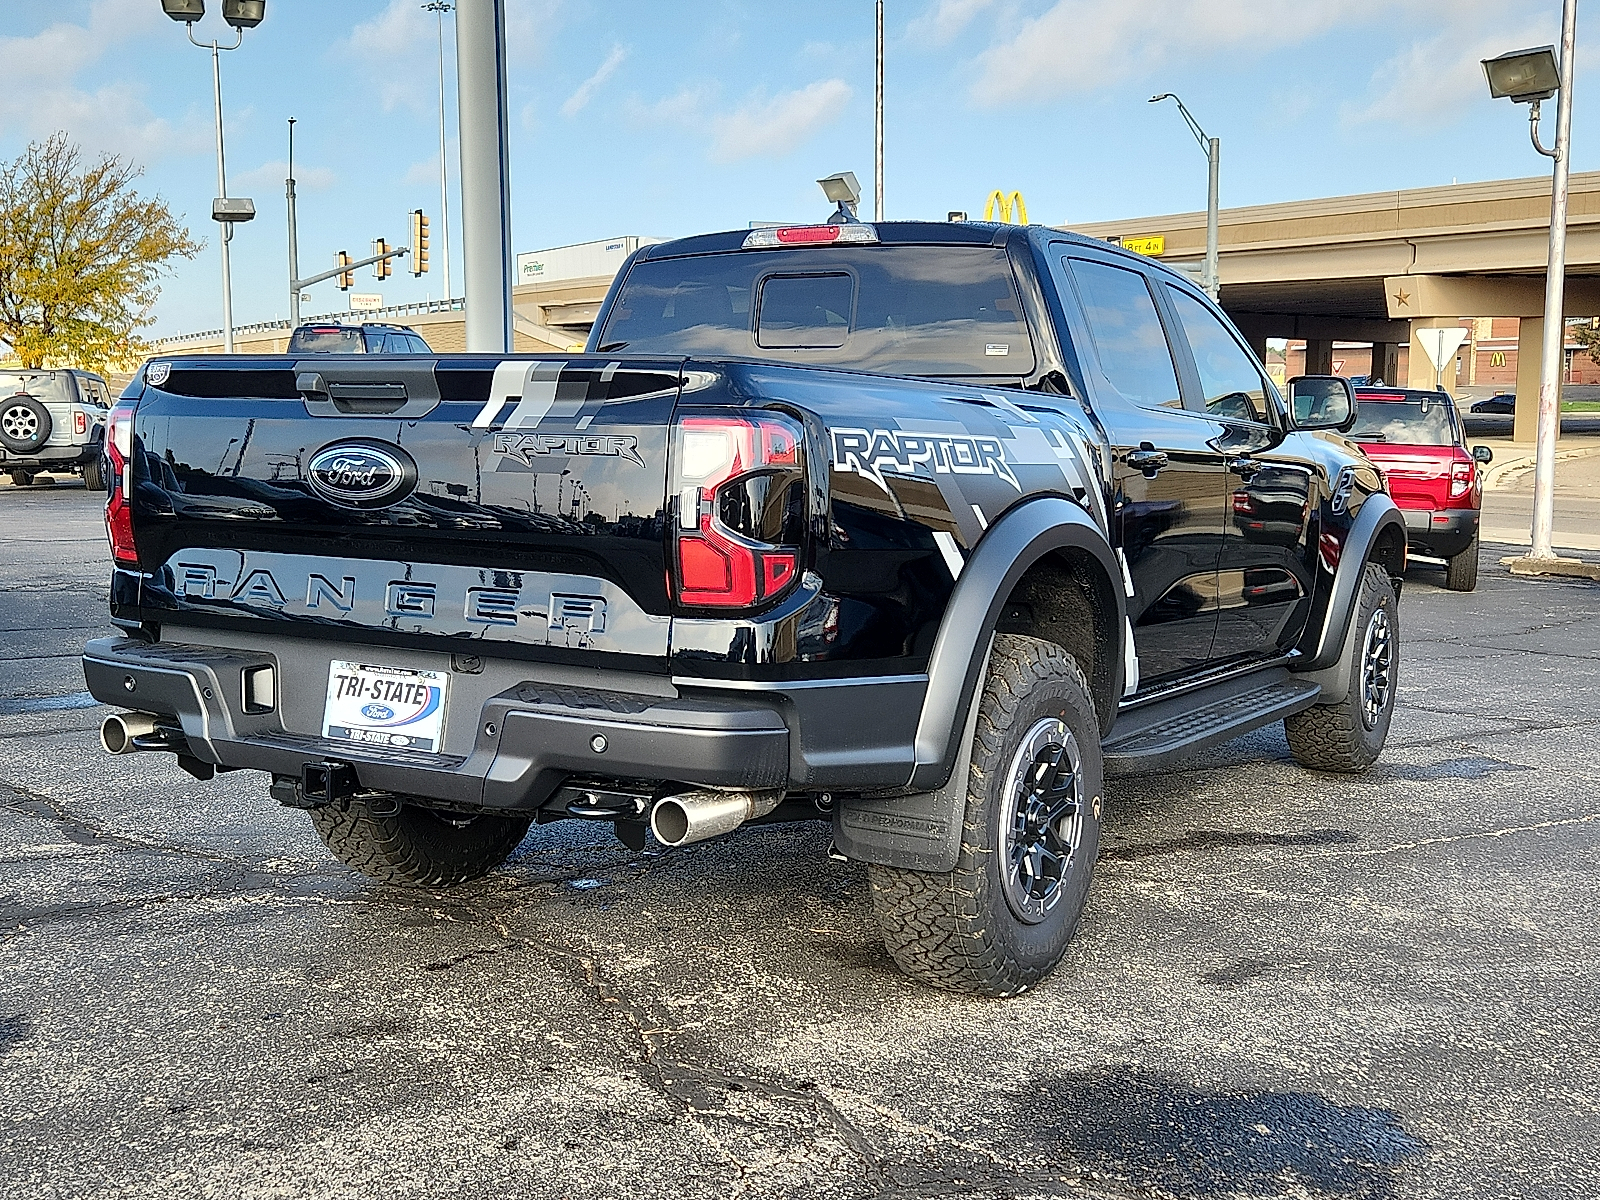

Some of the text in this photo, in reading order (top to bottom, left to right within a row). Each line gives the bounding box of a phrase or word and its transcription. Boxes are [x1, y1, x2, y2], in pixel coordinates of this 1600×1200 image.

[523, 263, 545, 274] Premier
[494, 433, 647, 469] RAPTOR
[829, 427, 1023, 494] RAPTOR
[328, 457, 378, 486] Ford
[174, 562, 608, 634] RANGER
[336, 674, 427, 705] TRI-STATE
[366, 704, 389, 720] Ford
[349, 728, 391, 744] TRI-STATE
